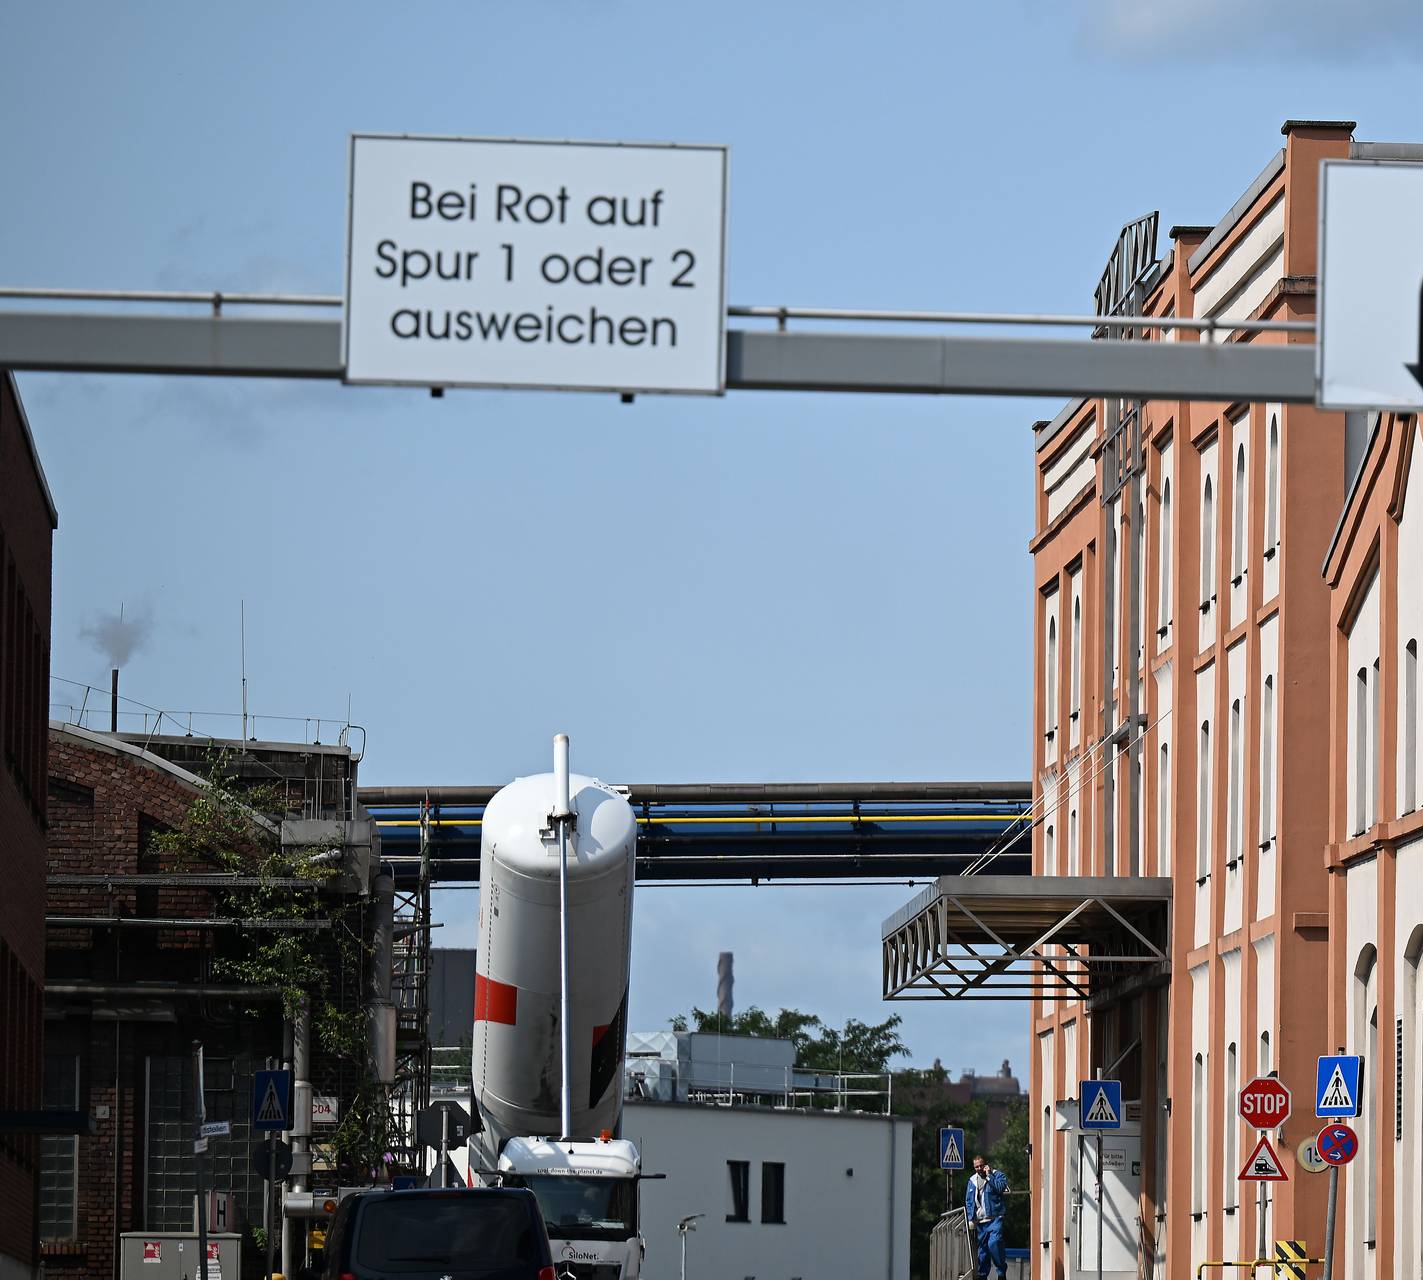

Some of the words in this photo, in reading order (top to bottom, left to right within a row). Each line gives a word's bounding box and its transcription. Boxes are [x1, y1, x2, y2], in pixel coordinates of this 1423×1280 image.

[410, 181, 477, 222] Bei
[496, 184, 570, 224] Rot
[586, 189, 664, 228] auf
[375, 239, 479, 288] Spur
[500, 244, 515, 282] 1
[540, 248, 653, 287] oder
[670, 250, 696, 288] 2
[390, 305, 678, 347] ausweichen
[311, 1104, 331, 1114] C04
[1243, 1093, 1286, 1114] STOP
[216, 1199, 226, 1227] H
